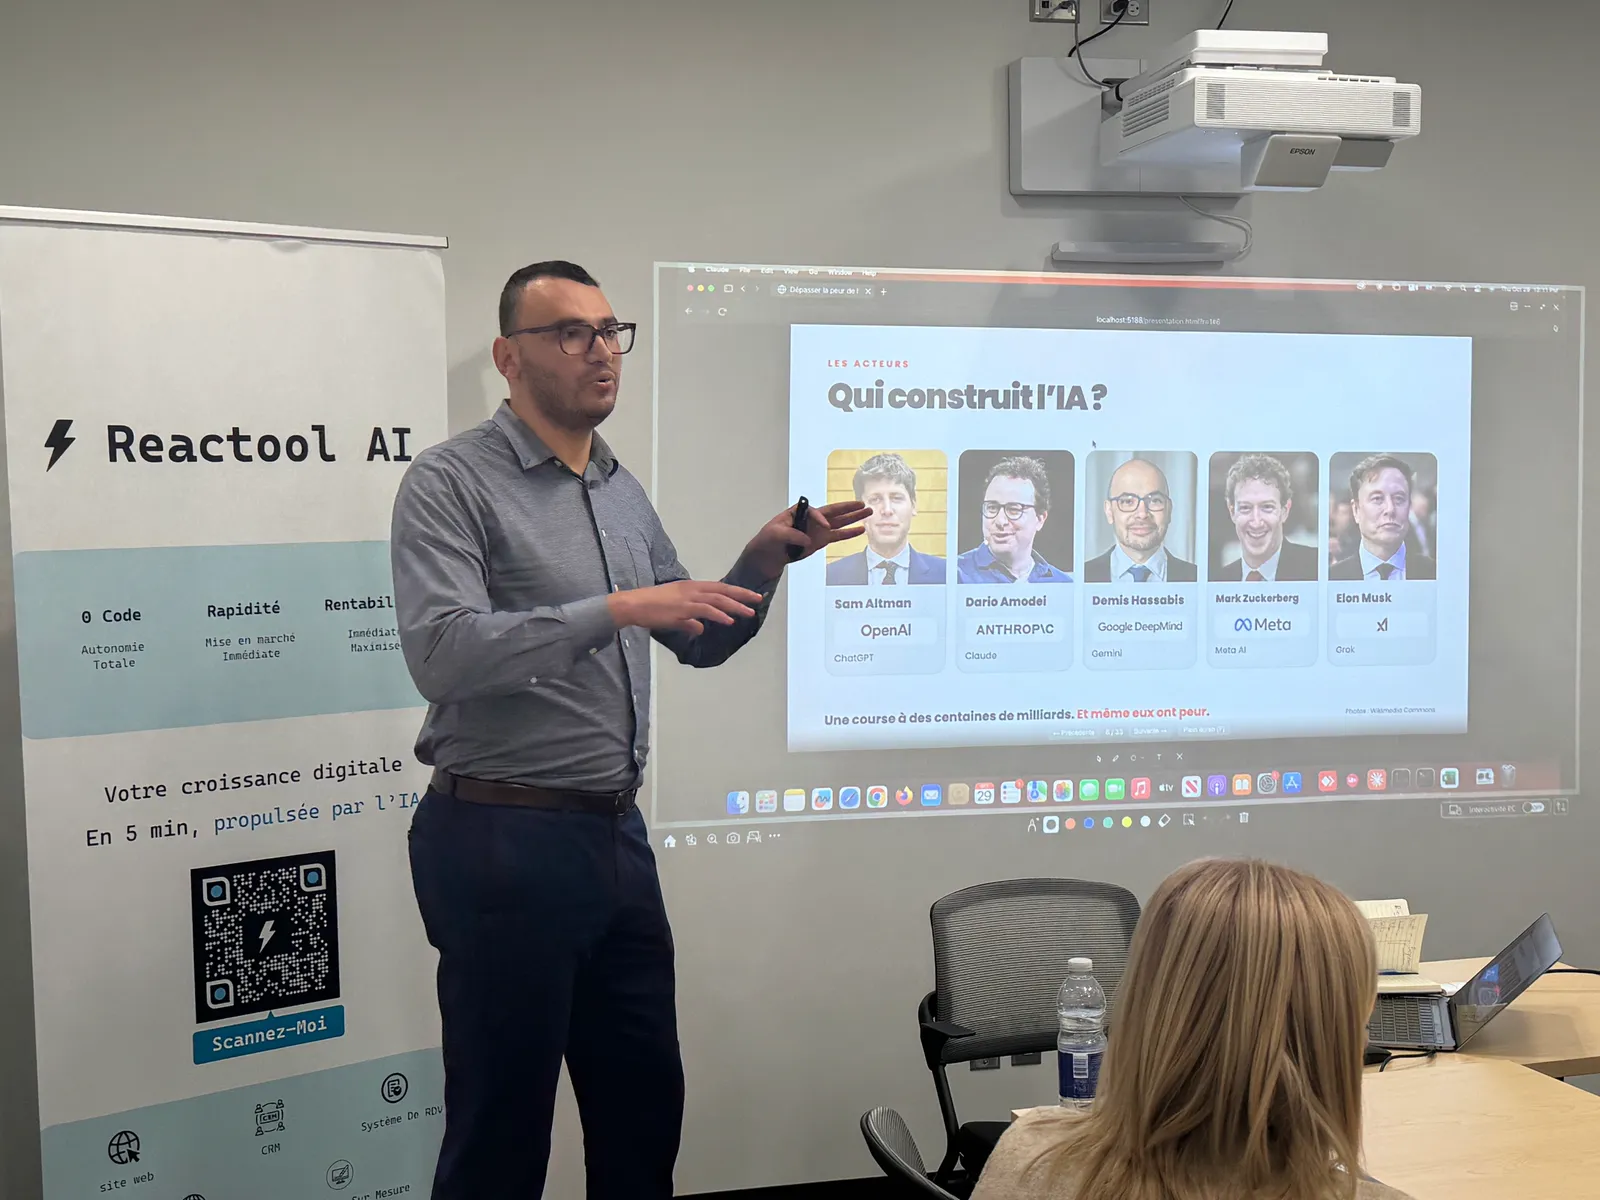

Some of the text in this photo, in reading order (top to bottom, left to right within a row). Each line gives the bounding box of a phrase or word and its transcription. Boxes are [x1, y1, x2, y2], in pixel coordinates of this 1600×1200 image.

[1289, 147, 1316, 156] EPSON
[789, 286, 821, 295] Dépasser
[829, 287, 845, 295] peur
[827, 359, 910, 369] LES ACTEURS
[827, 378, 885, 413] Qui
[887, 380, 1034, 411] construit
[106, 424, 413, 464] Reactool AI
[324, 595, 394, 611] Rentabil
[834, 597, 912, 610] Sam Altman
[965, 595, 1048, 608] Dario Amodei
[1091, 593, 1185, 607] Demis Hassabis
[1215, 592, 1300, 607] Mark Zuckerberg
[1336, 591, 1393, 605] Elon Musk
[102, 608, 142, 624] Code
[207, 601, 281, 619] Rapidité
[860, 623, 912, 640] OpenAI
[1097, 620, 1184, 635] Google DeepMind
[1253, 617, 1292, 632] Meta
[205, 632, 297, 648] Mise en marché
[347, 627, 400, 639] Immédiat
[81, 641, 145, 655] Autonomie
[1091, 648, 1123, 659] Gemini
[1214, 645, 1247, 656] Meta AI
[1335, 644, 1356, 655] Grok
[223, 649, 282, 662] Immédiate
[834, 652, 875, 664] ChatGPT
[964, 650, 998, 661] Claude
[93, 658, 136, 670] Totale
[824, 704, 1211, 726] Une course à des centaines de milliards. Et même eux ont peur.
[1345, 707, 1367, 715] Photos
[1371, 706, 1402, 715] Wikimedia
[1403, 706, 1436, 714] Commons
[104, 756, 402, 804] Votre croissance digitale
[977, 790, 992, 802] 29
[86, 829, 113, 847] En
[125, 825, 138, 843] 5
[150, 819, 200, 840] min,
[213, 803, 320, 836] propulsée
[331, 799, 365, 821] par
[212, 1015, 327, 1052] Scannez-Moi
[361, 1105, 443, 1133] Système De RDV
[261, 1142, 281, 1156] CRM
[99, 1171, 155, 1193] site web
[375, 1183, 411, 1200] Mesure
